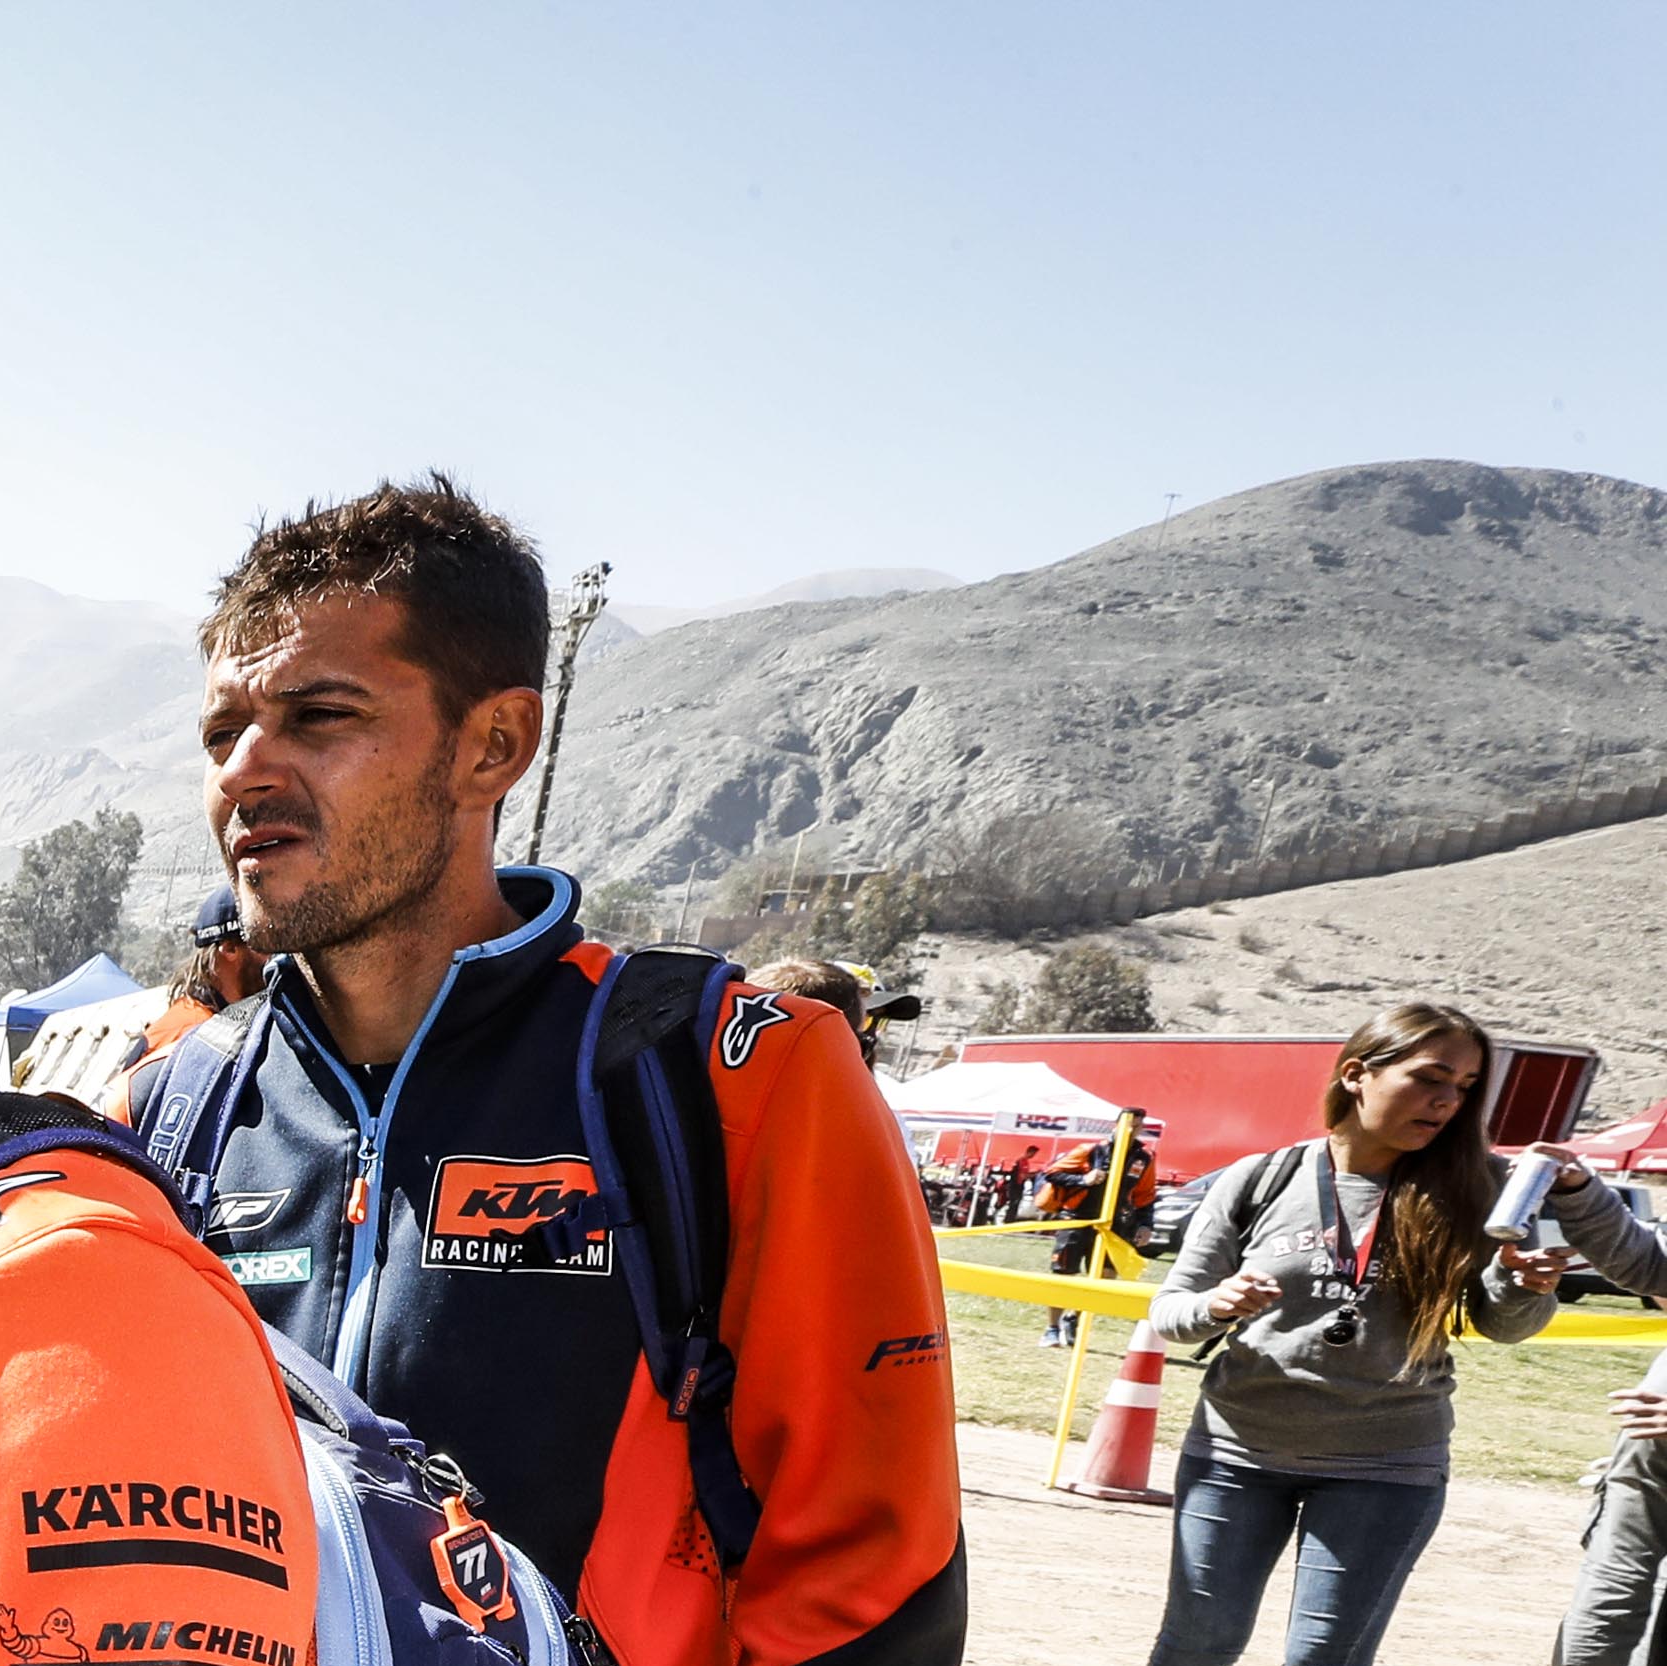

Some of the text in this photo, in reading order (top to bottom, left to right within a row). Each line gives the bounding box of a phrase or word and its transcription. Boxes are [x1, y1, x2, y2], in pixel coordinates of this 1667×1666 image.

[1016, 1113, 1068, 1131] HRC
[21, 1482, 285, 1555] KÄRCHER
[456, 1542, 487, 1586] 77
